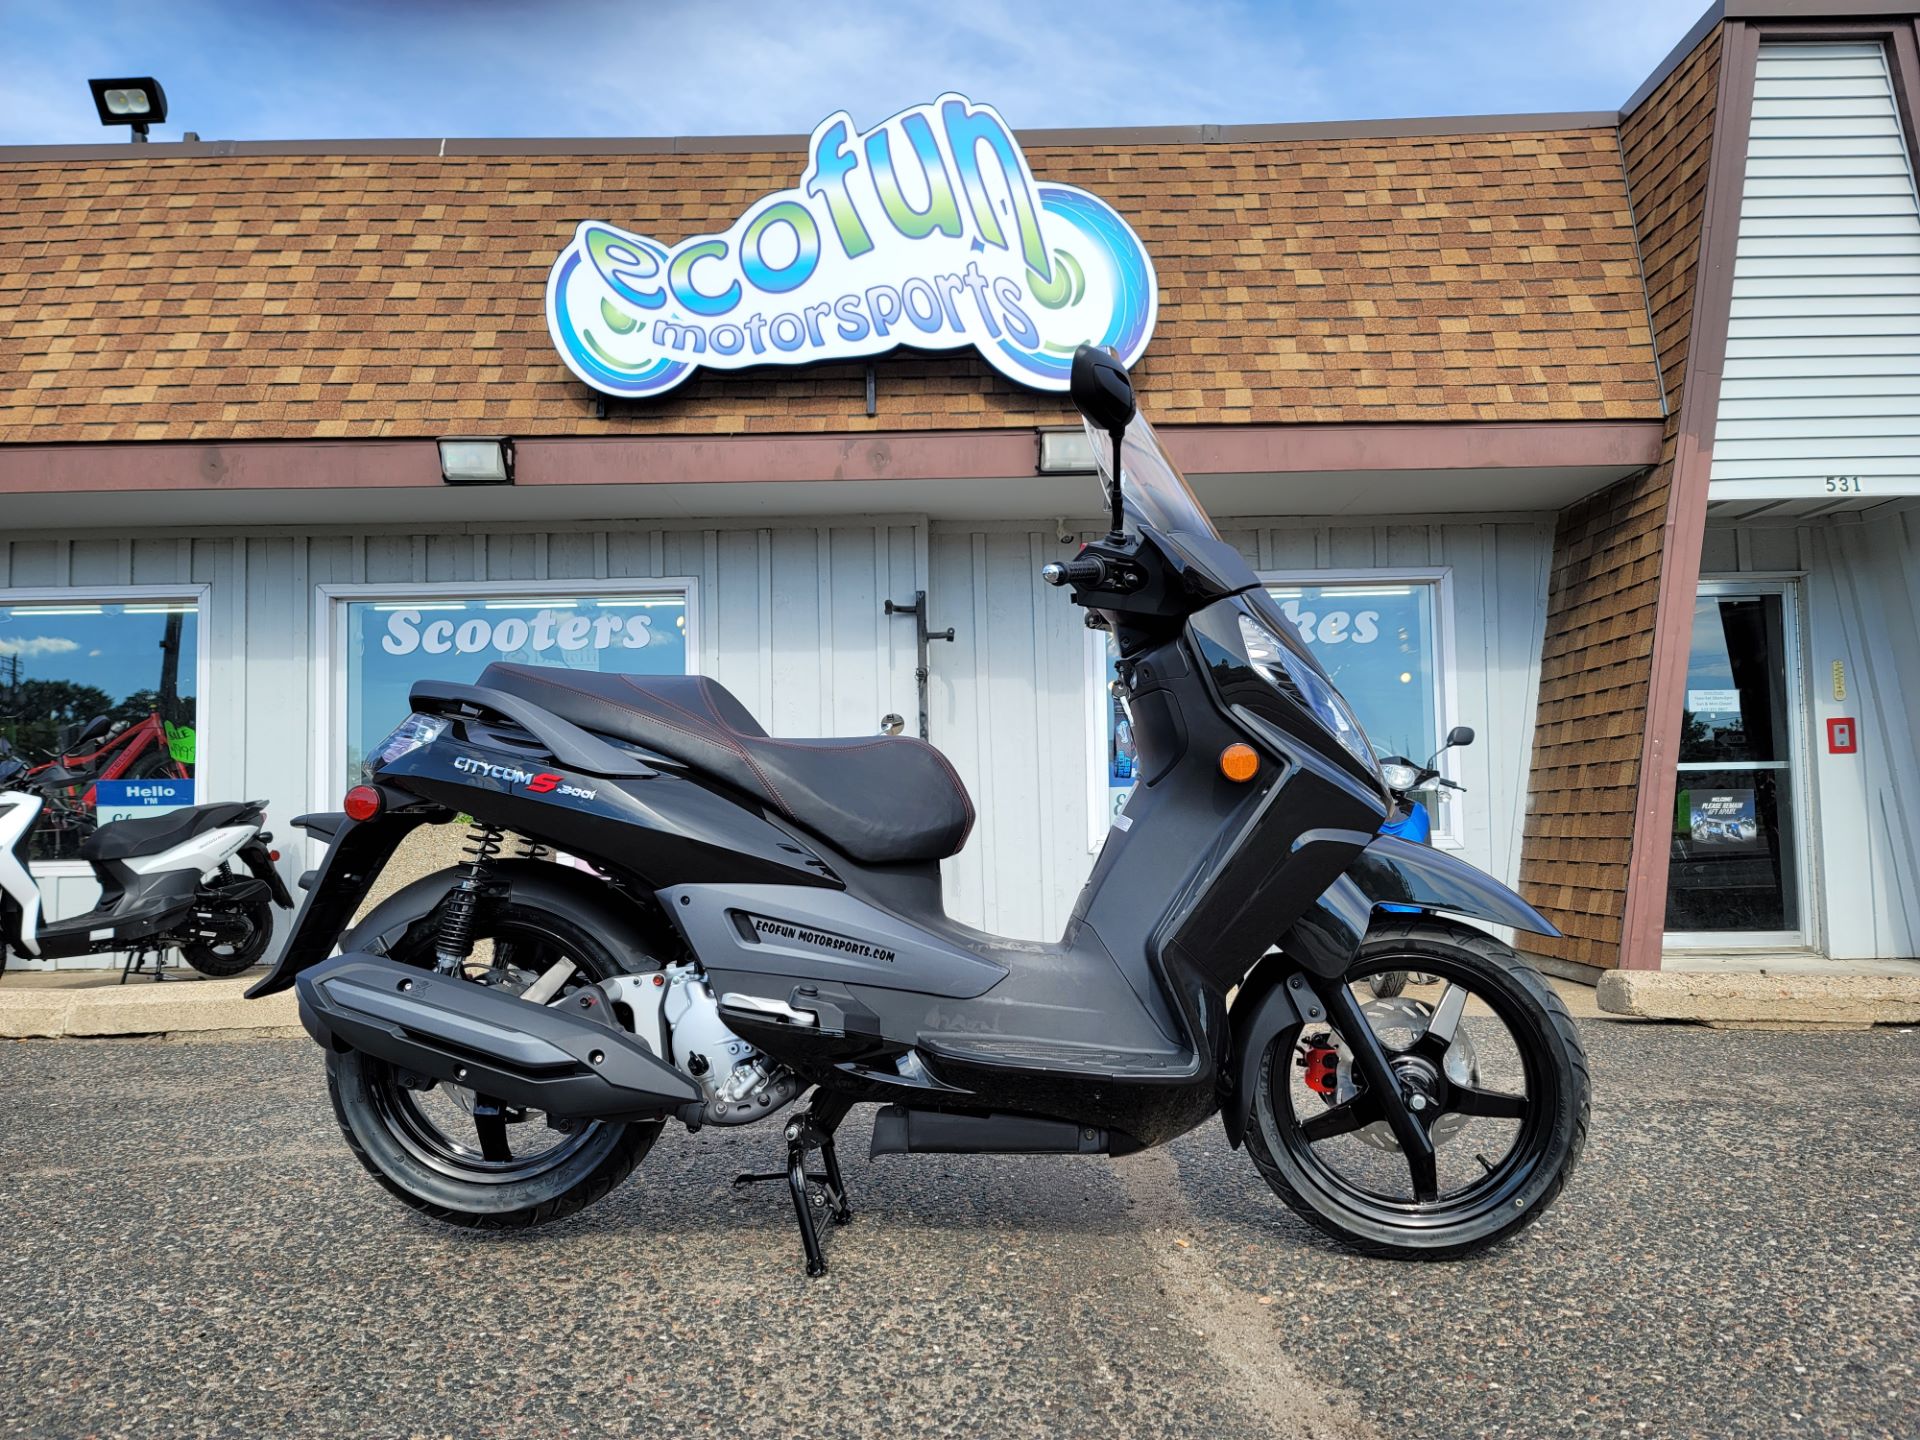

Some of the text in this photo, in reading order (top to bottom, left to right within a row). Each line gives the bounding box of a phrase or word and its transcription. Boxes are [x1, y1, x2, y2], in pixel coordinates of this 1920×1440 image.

[652, 261, 1040, 356] motorsports
[1826, 475, 1861, 492] 531
[382, 609, 652, 656] Scooters
[1281, 600, 1380, 644] kes
[126, 786, 175, 797] Hello
[756, 920, 895, 962] ECOFUN MOTORSPORTS.COM
